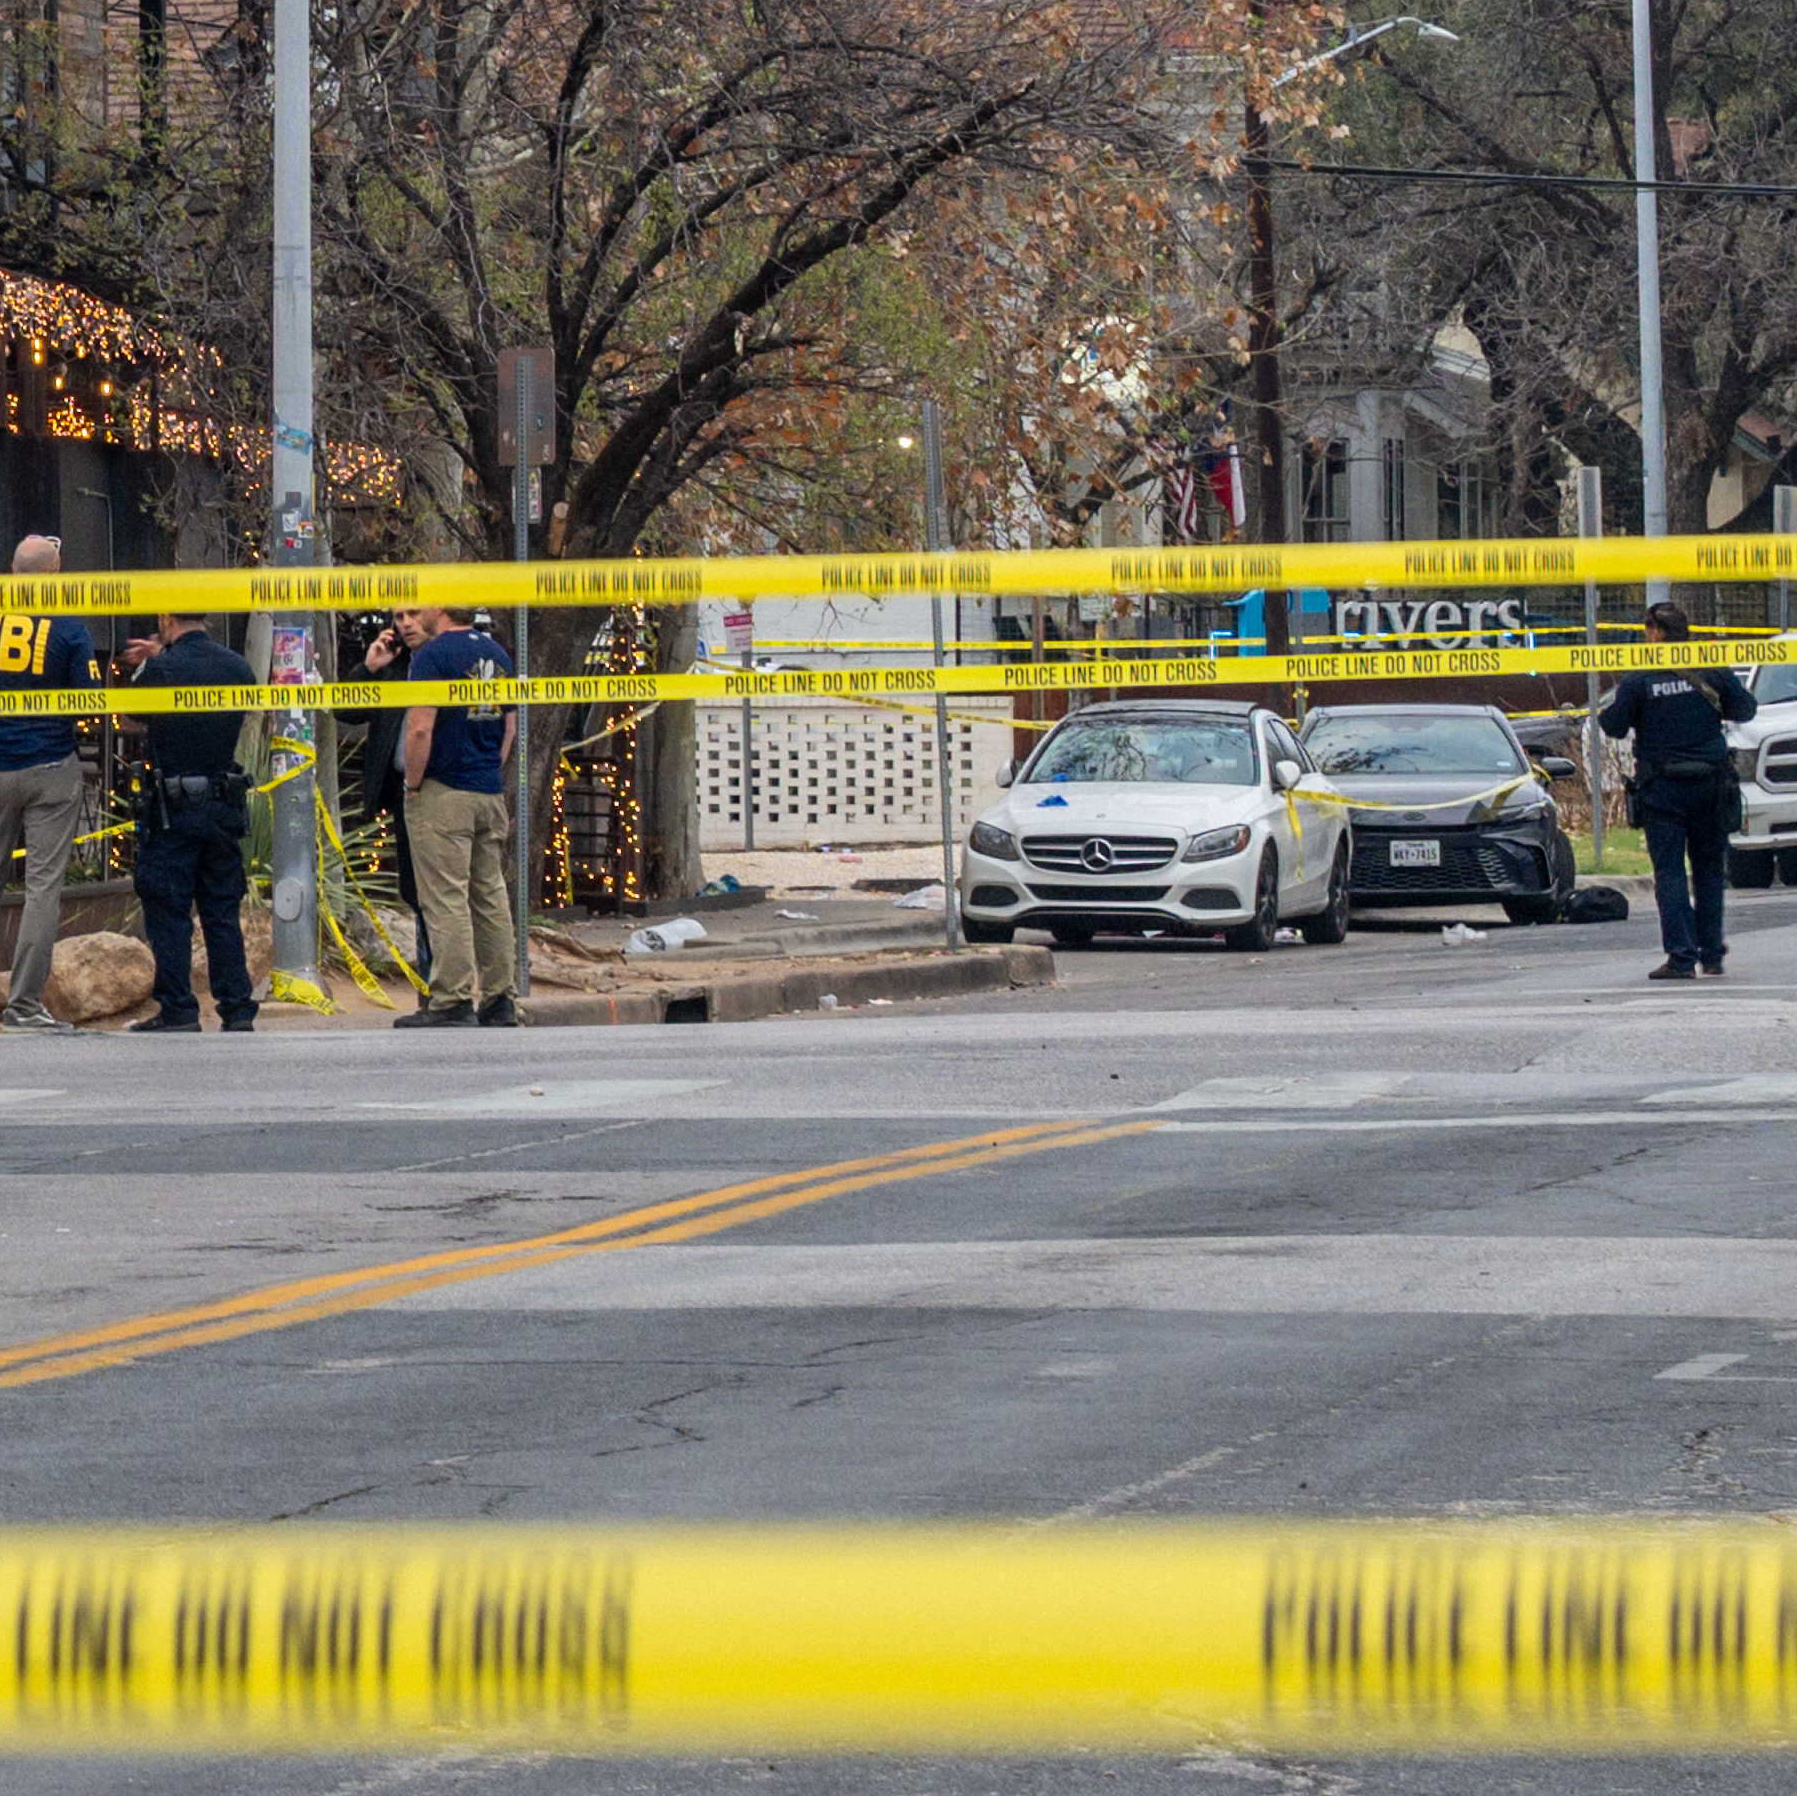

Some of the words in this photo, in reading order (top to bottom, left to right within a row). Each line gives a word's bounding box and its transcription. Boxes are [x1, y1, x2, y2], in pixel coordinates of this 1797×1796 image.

[1286, 658, 1336, 677] POLICE
[1345, 657, 1375, 675] LINE
[1385, 656, 1406, 674] DO
[1412, 655, 1441, 673] NOT
[1448, 653, 1500, 672] CROSS
[1570, 648, 1621, 667] POLICE
[1630, 647, 1661, 665] LINE
[1670, 646, 1692, 664] DO
[1697, 645, 1727, 663] NOT
[1734, 643, 1787, 662] CROSS
[724, 675, 775, 694] POLICE
[783, 674, 813, 692] LINE
[822, 673, 843, 691] DO
[849, 672, 877, 690] NOT
[885, 670, 936, 689] CROSS
[1004, 666, 1055, 685] POLICE
[1063, 665, 1094, 684] LINE
[1102, 664, 1123, 683] DO
[1129, 663, 1158, 682] NOT
[1165, 661, 1217, 681] CROSS
[173, 691, 223, 708] POLICE
[231, 690, 261, 707] LINE
[270, 689, 291, 706] DO
[296, 688, 324, 706] NOT
[331, 686, 381, 705] CROSS
[448, 683, 498, 700] POLICE
[506, 682, 536, 699] LINE
[545, 681, 565, 698] DO
[571, 680, 599, 698] NOT
[606, 678, 657, 697] CROSS
[22, 693, 50, 711] NOT
[57, 692, 107, 711] CROSS
